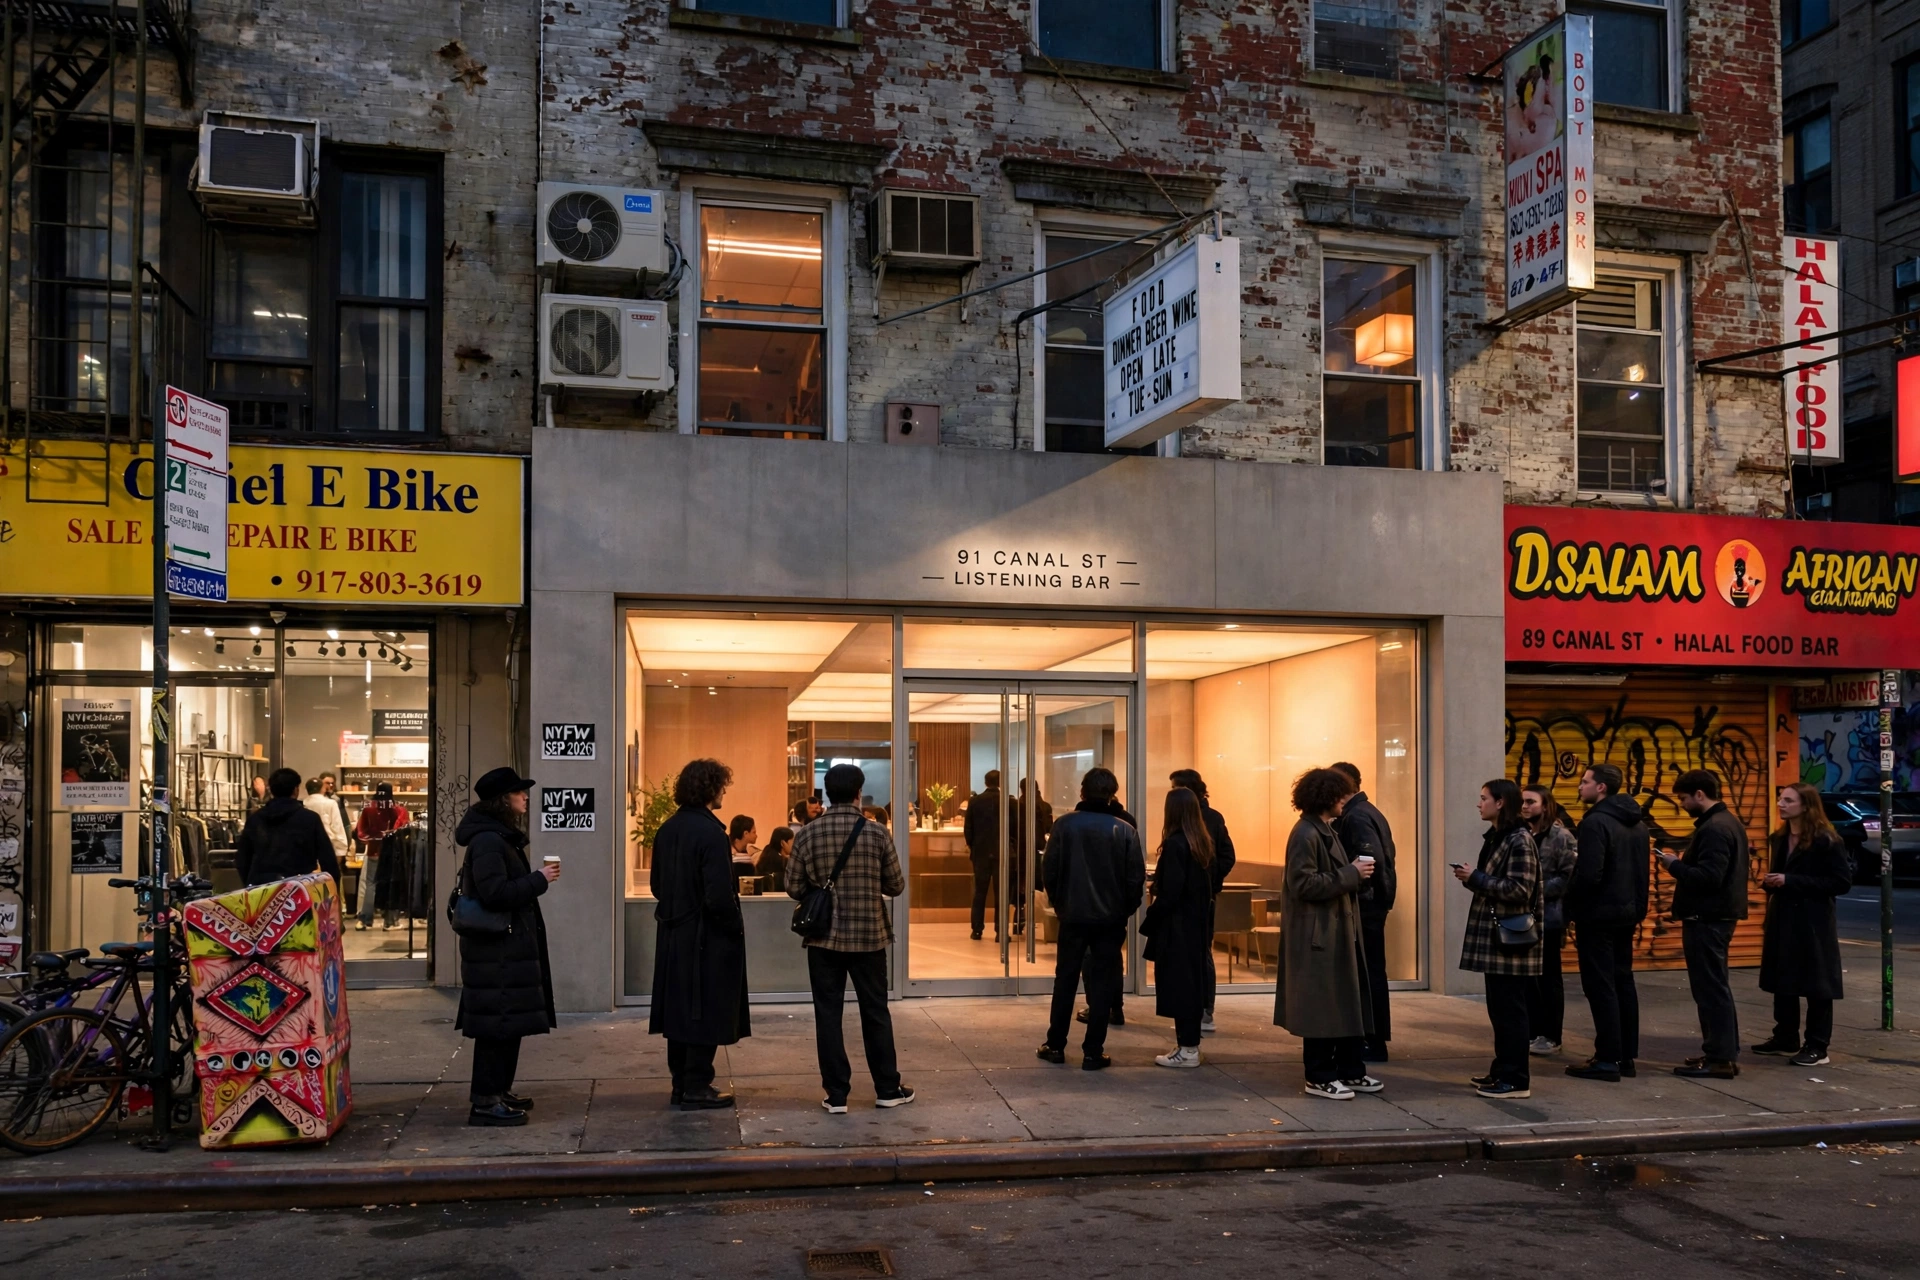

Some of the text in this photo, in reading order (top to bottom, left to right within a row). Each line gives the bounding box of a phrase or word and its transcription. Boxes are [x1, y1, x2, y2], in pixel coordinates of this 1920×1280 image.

[1536, 147, 1563, 195] SPA
[1133, 279, 1164, 323] FOOD
[1795, 239, 1827, 350] HALAL
[1145, 308, 1167, 346] BEER
[1172, 289, 1197, 330] WINE
[1121, 335, 1176, 392] OPEN LATE
[307, 465, 345, 508] E
[364, 467, 479, 514] Bike
[67, 518, 142, 545] SALE
[228, 523, 311, 550] EPAIR
[319, 526, 338, 551] E
[346, 527, 418, 553] BIKE
[957, 549, 1107, 569] 91 CANAL ST
[1786, 551, 1918, 592] AFRICAN
[297, 569, 482, 597] 917-803-3619
[955, 571, 1110, 590] LISTENING BAR
[1522, 628, 1839, 657] 89 CANAL ST HALAL FOOD BAR
[545, 725, 590, 740] NYFW
[545, 742, 593, 756] SEP 2026
[544, 789, 587, 808] NYFW
[545, 813, 592, 828] SEP 2026
